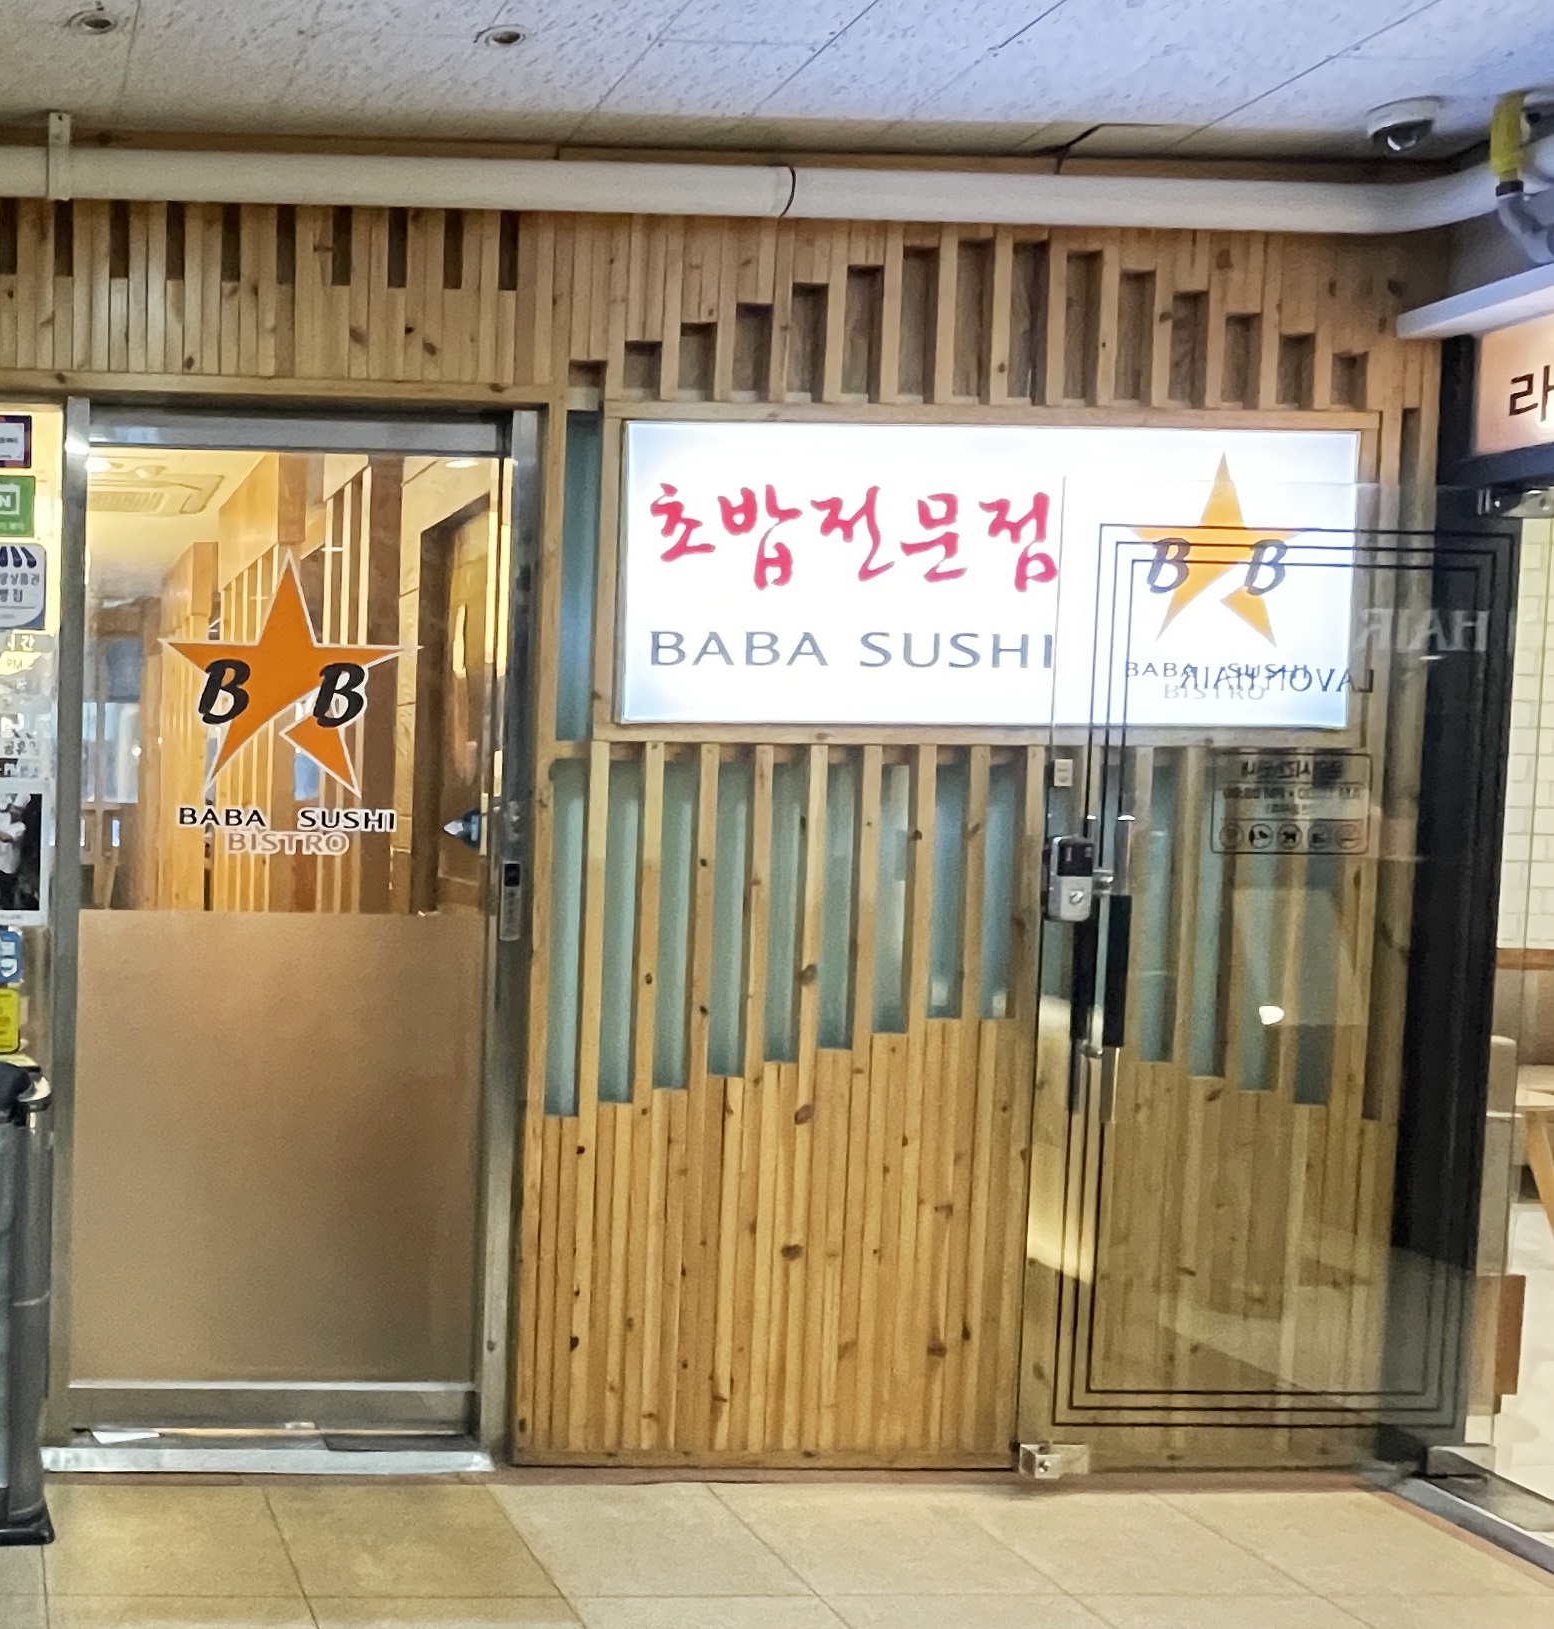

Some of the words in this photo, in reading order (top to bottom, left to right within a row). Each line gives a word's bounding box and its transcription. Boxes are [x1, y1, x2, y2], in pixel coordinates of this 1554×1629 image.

[650, 482, 1059, 593] 초밥전문점
[1145, 536, 1192, 595] B
[1243, 538, 1289, 596] B
[650, 630, 830, 668] BABA
[859, 631, 1055, 669] SUSHI
[198, 658, 251, 725] B
[312, 661, 367, 728] B
[179, 806, 267, 828] BABA
[299, 809, 396, 831] SUSHI
[228, 832, 348, 854] BISTRO
